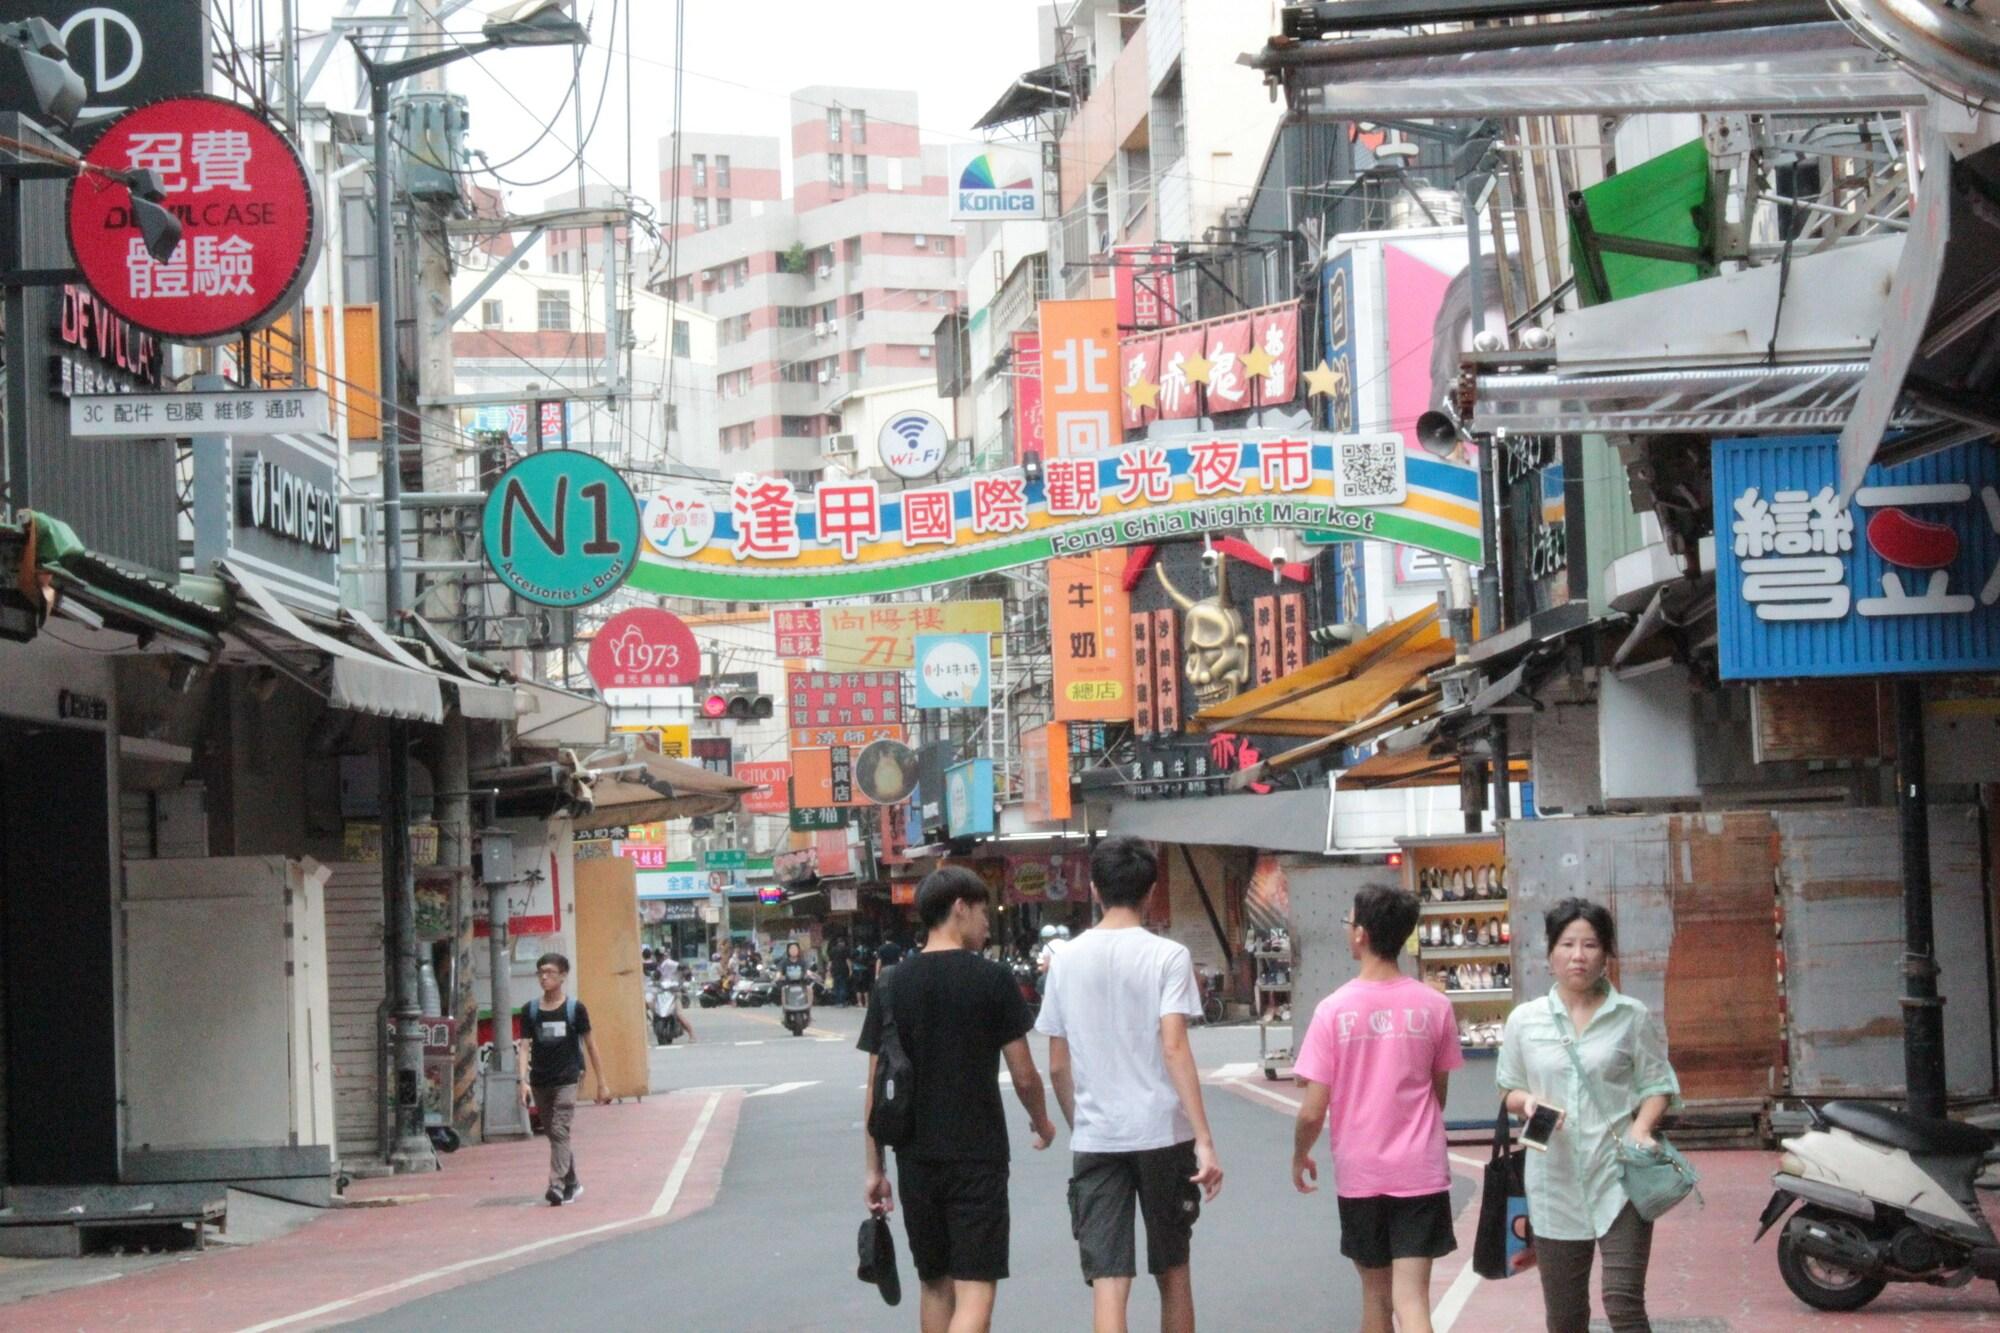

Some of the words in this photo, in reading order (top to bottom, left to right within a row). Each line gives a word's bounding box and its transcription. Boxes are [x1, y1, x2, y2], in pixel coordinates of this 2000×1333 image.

[126, 130, 251, 193] 免費
[959, 191, 1034, 212] Konica
[126, 235, 255, 299] 體驗
[83, 406, 103, 423] 3C
[114, 403, 153, 422] 配件
[165, 402, 204, 421] 包膜
[214, 402, 253, 420] 維修
[265, 400, 304, 419] 通訊
[890, 448, 940, 466] Wi-Fi
[502, 475, 620, 557] N1
[734, 436, 1313, 555] 逢甲國際觀光夜市
[1051, 524, 1116, 554] Feng
[1122, 513, 1183, 539] Chia
[1191, 504, 1264, 532] Night
[1271, 503, 1375, 531] Market
[501, 561, 577, 600] Accessories
[582, 583, 593, 596] &
[593, 557, 624, 589] Bags
[1068, 582, 1096, 658] 牛奶
[627, 643, 680, 673] 1973
[1072, 682, 1116, 700] 總店
